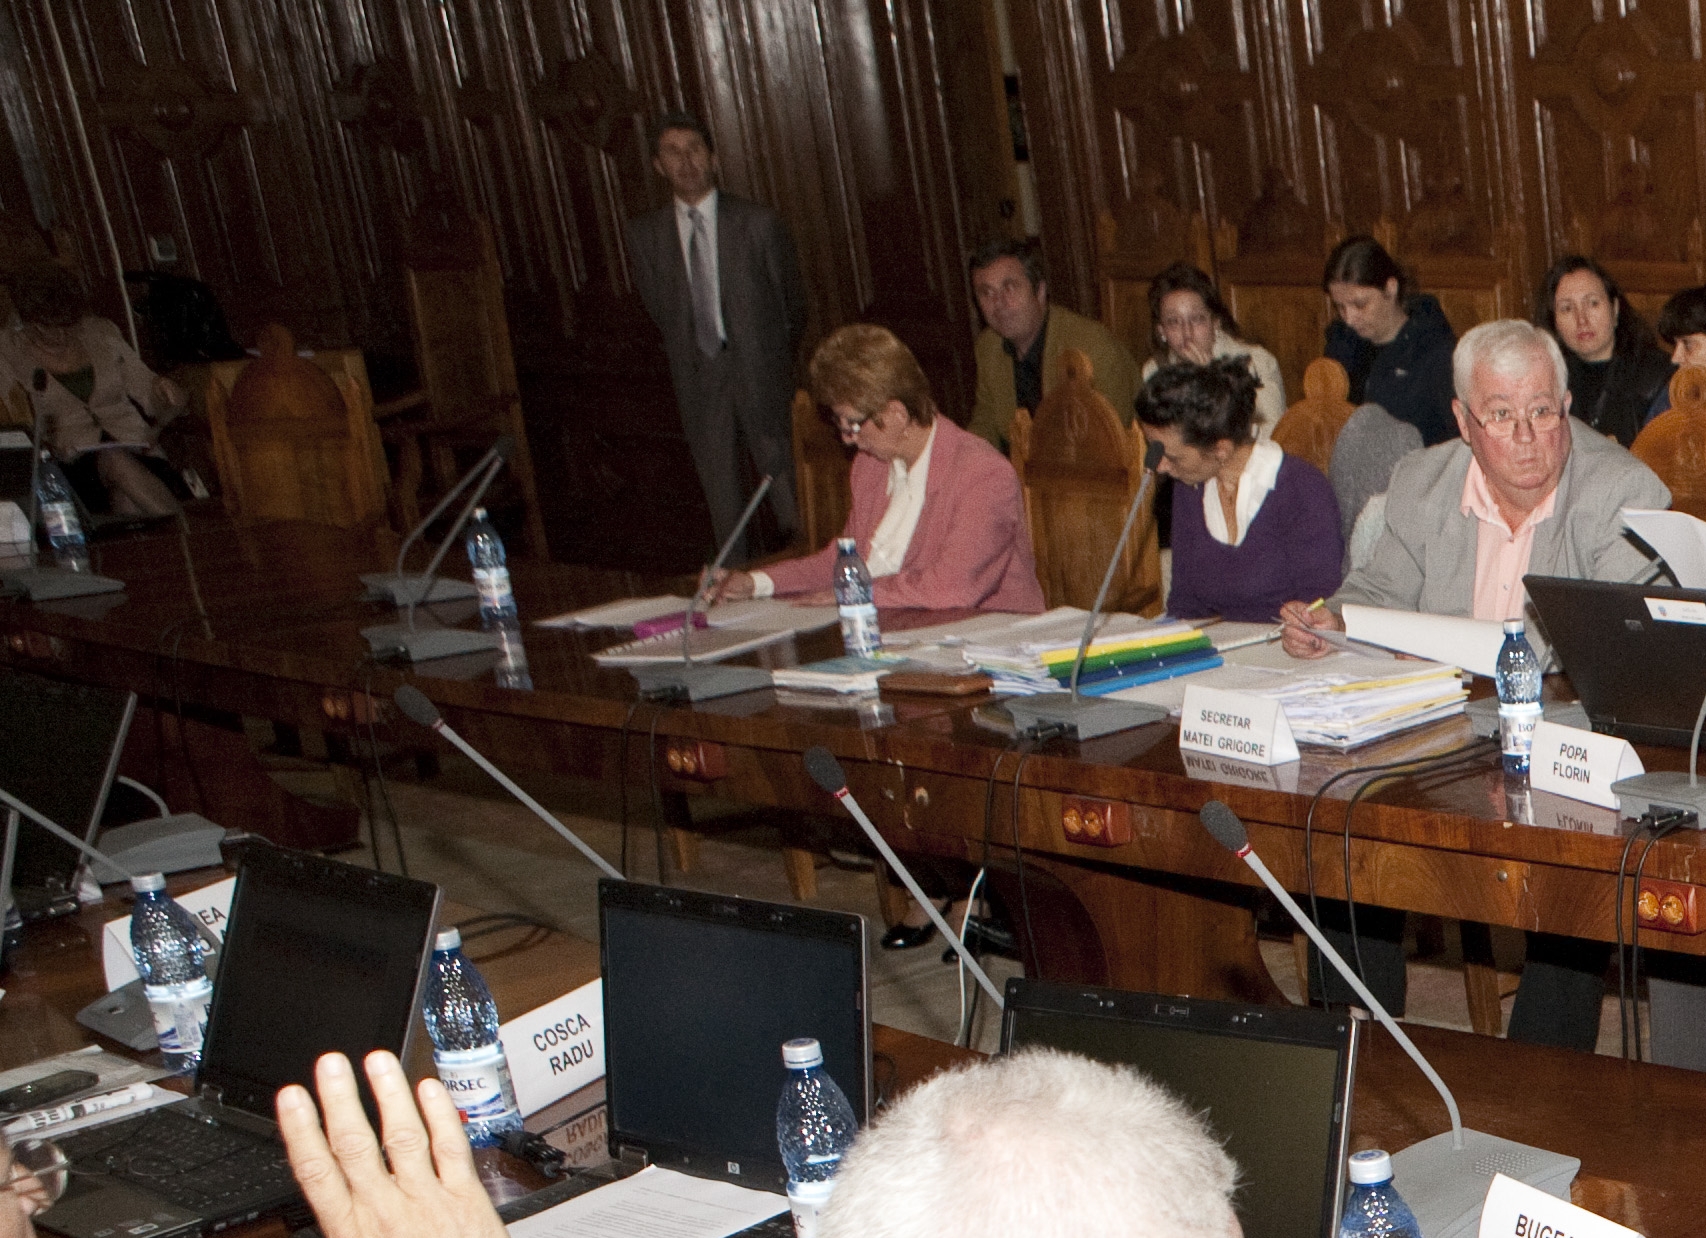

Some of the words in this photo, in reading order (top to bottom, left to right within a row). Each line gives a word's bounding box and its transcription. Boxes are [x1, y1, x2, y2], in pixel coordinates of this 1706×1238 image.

[1200, 709, 1251, 730] SECRETAR
[1183, 729, 1213, 747] MATEI
[1218, 736, 1265, 758] GRIGORE
[1559, 742, 1588, 763] POPA
[1553, 761, 1591, 784] FLORIN
[533, 1012, 591, 1052] COSCA
[549, 1039, 594, 1076] RADU
[442, 1076, 488, 1093] ORSEC
